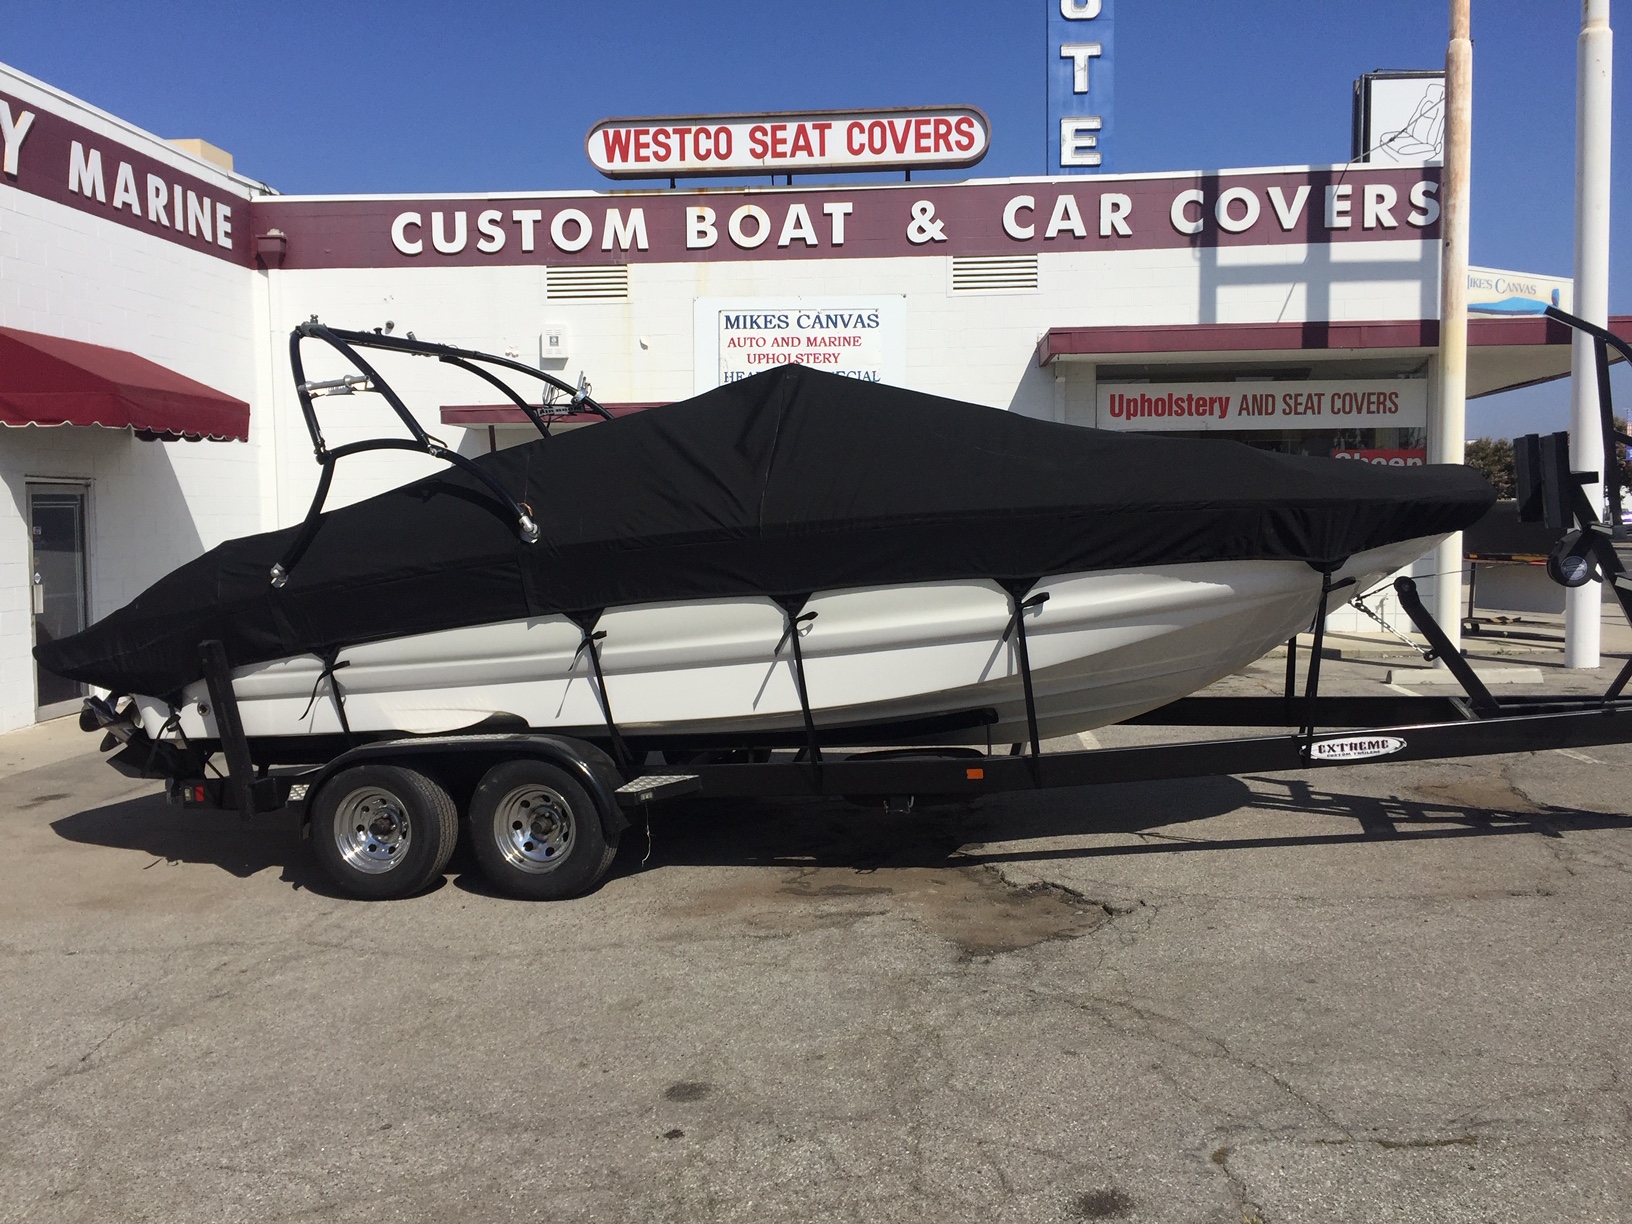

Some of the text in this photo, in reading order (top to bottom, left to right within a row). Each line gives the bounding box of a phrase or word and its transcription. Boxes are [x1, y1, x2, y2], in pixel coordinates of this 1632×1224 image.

[602, 116, 975, 163] WESTCO SEAT COVERS
[68, 140, 233, 250] MARINE
[391, 180, 1441, 255] CUSTOM BOAT & CAR COVERS
[724, 313, 880, 330] MIKES CANVAS
[727, 336, 862, 348] AUTO AND MARINE
[747, 353, 841, 364] UPHOLSTERY
[1109, 391, 1399, 420] Upholstery AND SEAT COVERS
[1318, 740, 1389, 754] EXTREME
